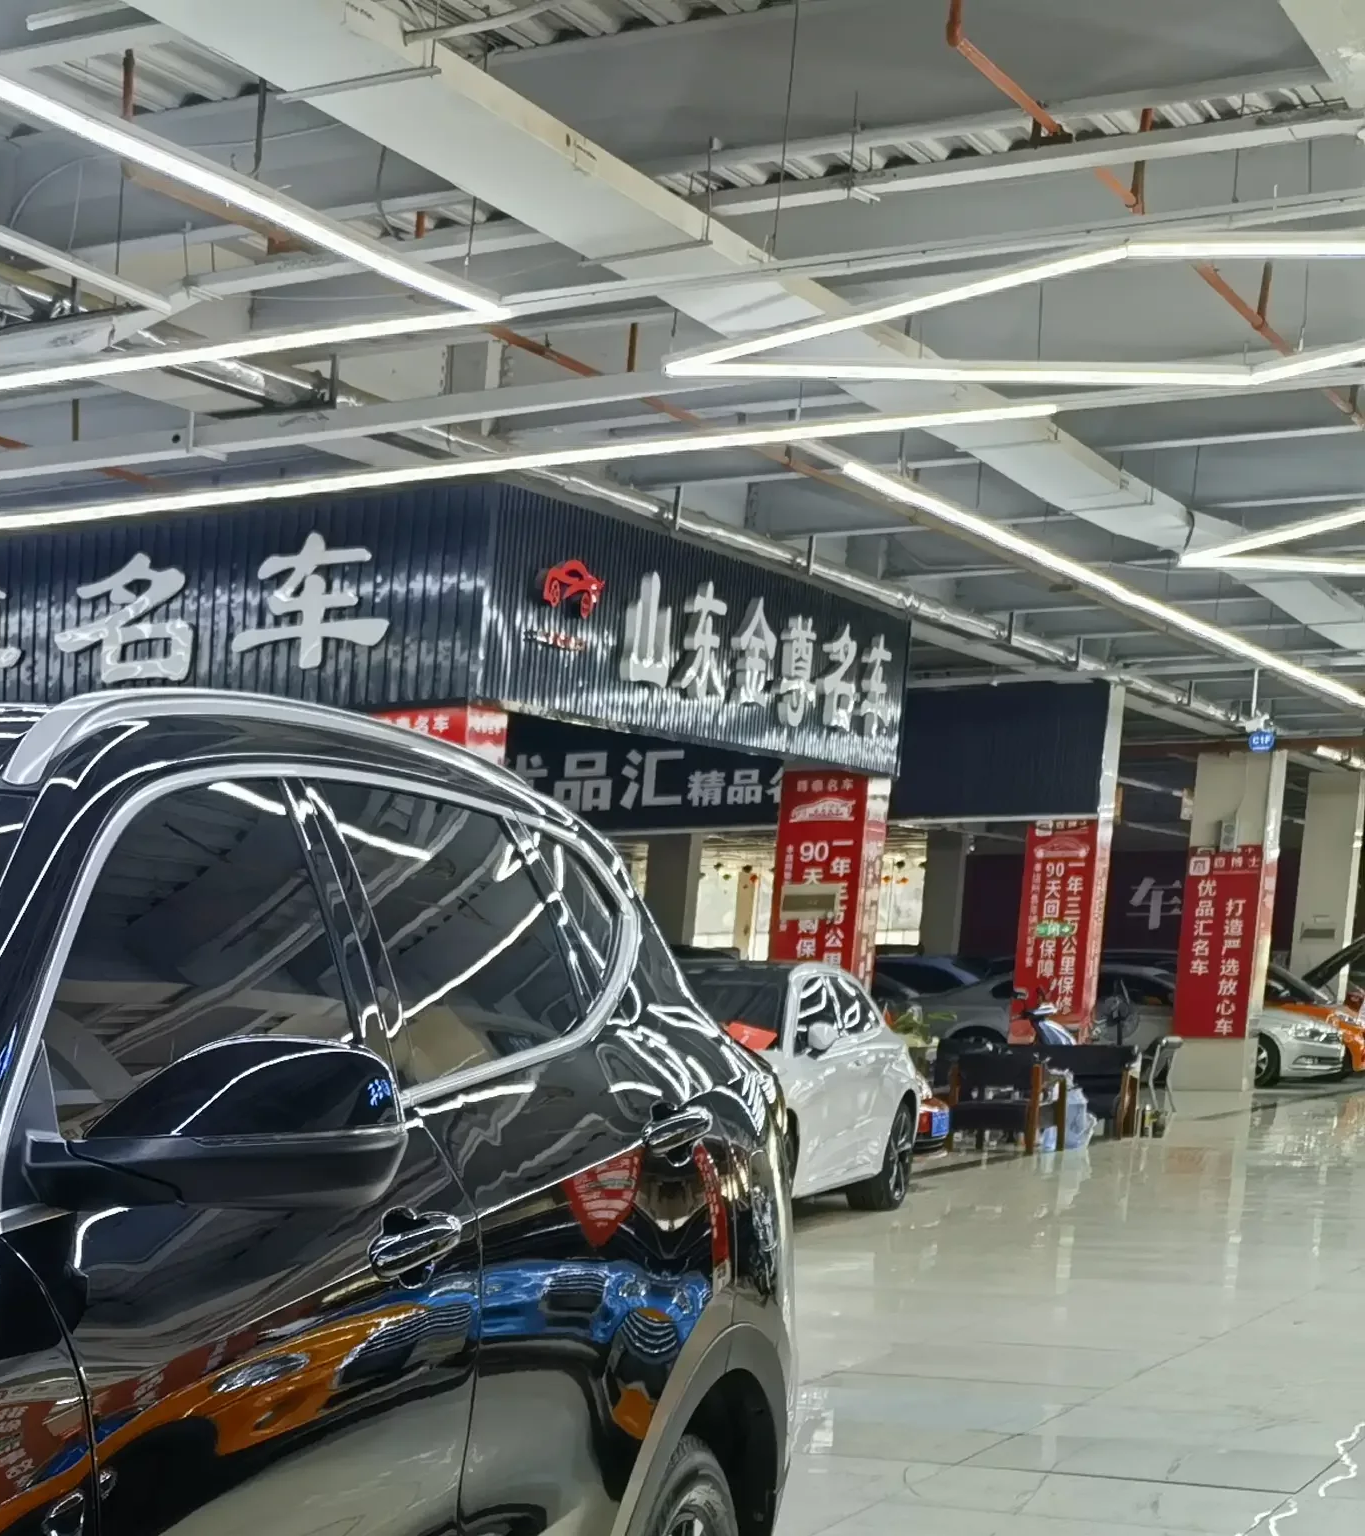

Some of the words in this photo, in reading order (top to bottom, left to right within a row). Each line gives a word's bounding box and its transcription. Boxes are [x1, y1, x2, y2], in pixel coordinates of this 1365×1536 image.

[619, 571, 893, 738] 山东金尊名车
[1189, 879, 1217, 976] 优品汇名车
[1214, 898, 1246, 1036] 打造严选放心车
